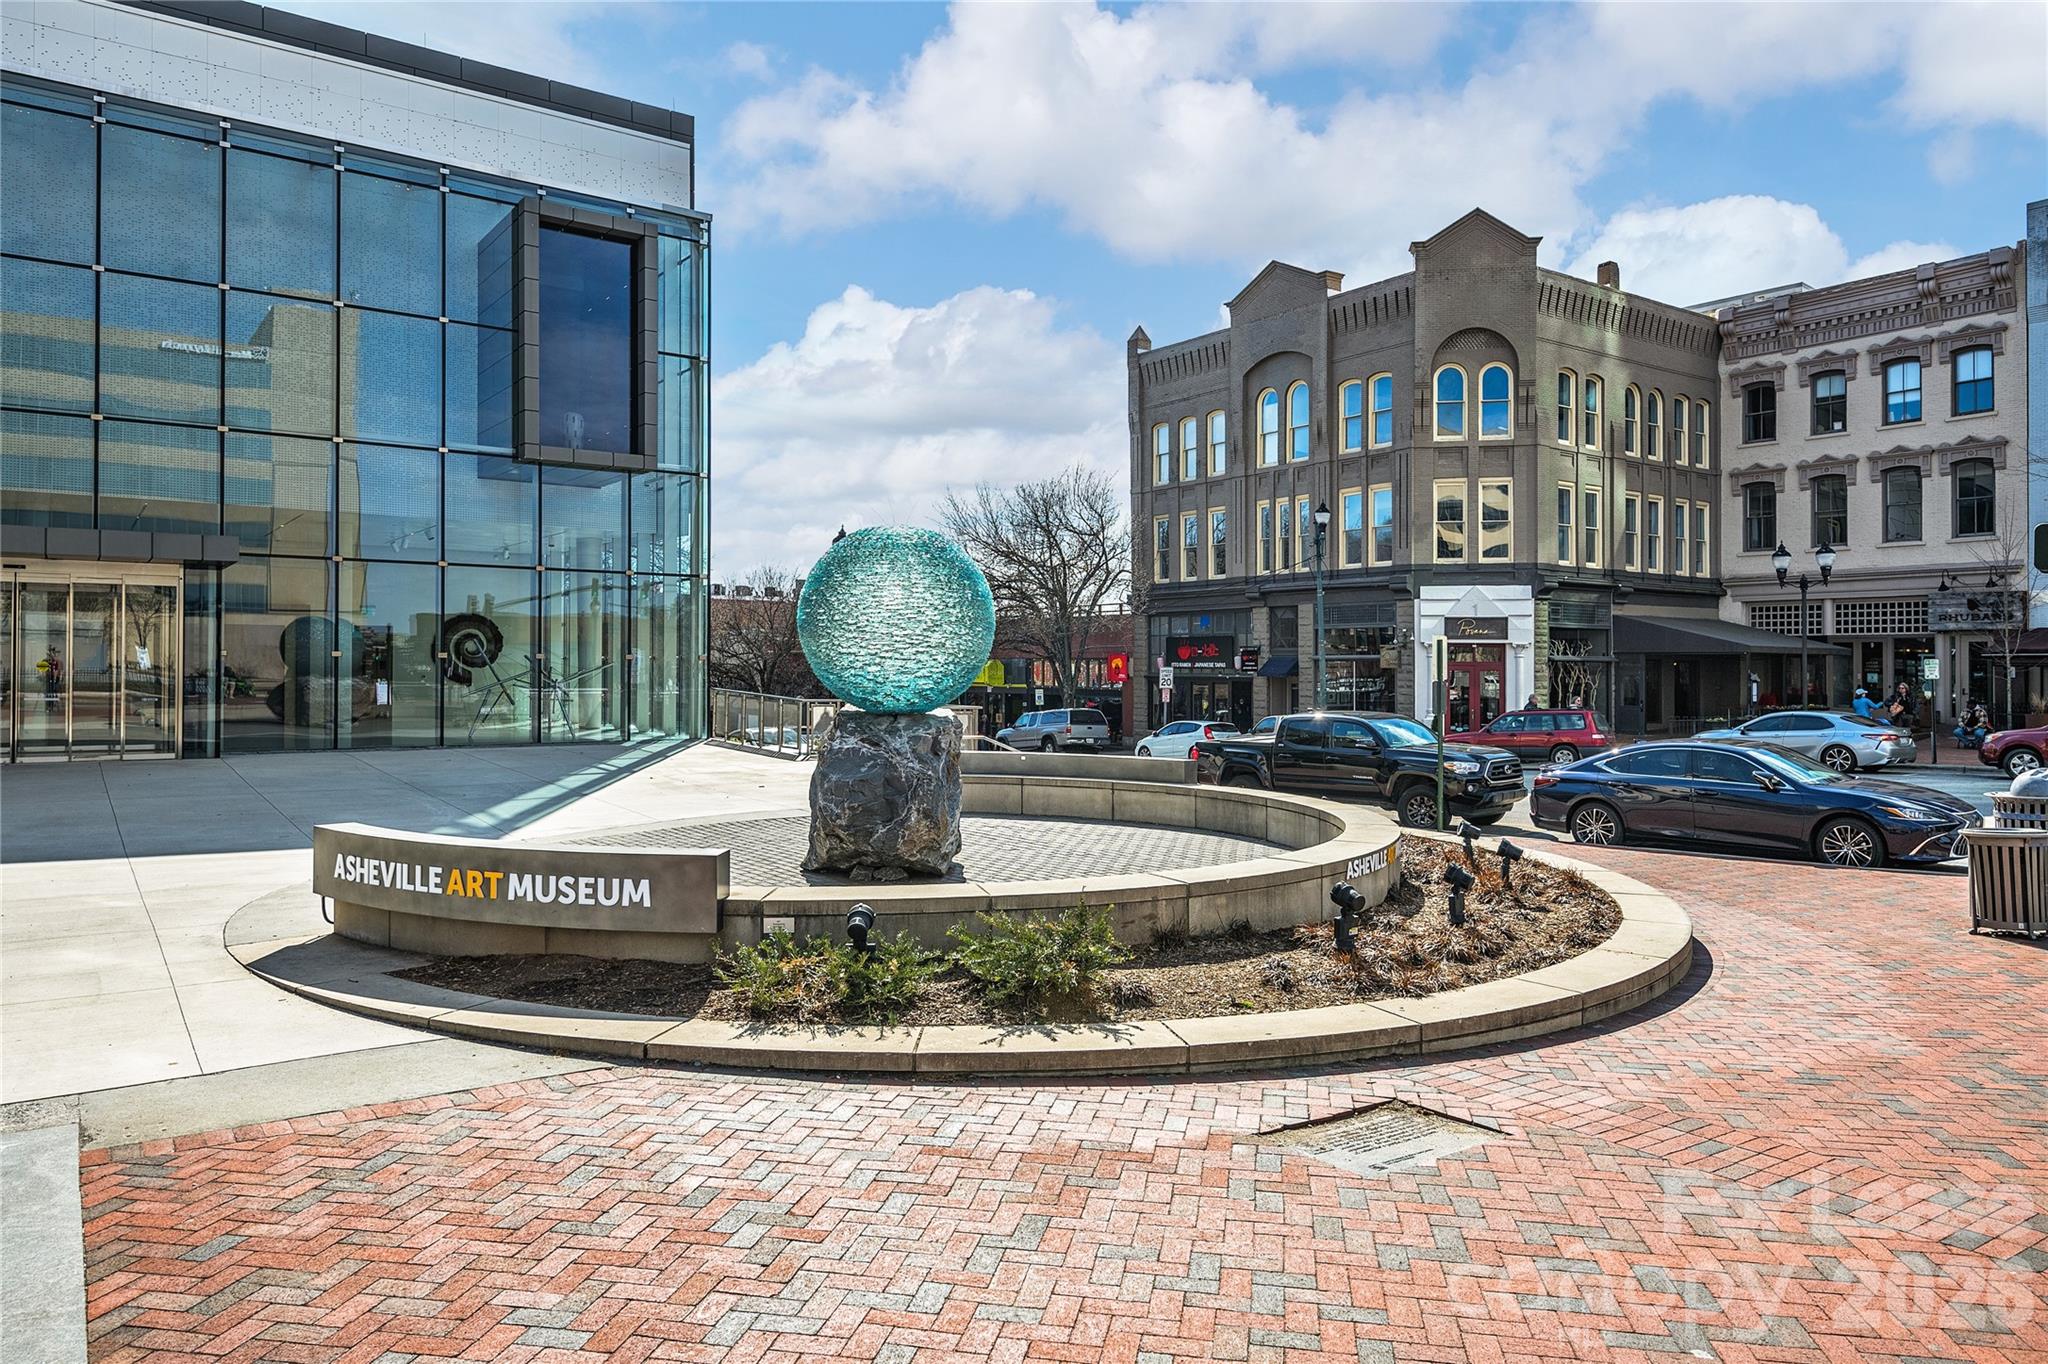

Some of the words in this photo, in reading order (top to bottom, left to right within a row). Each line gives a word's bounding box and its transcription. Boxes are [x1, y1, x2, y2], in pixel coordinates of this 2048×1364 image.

[1161, 678, 1172, 686] 20
[1347, 849, 1388, 880] ASHEVILLE
[333, 853, 443, 895] ASHEVILLE
[446, 868, 505, 900] ART
[507, 873, 652, 908] MUSEUM
